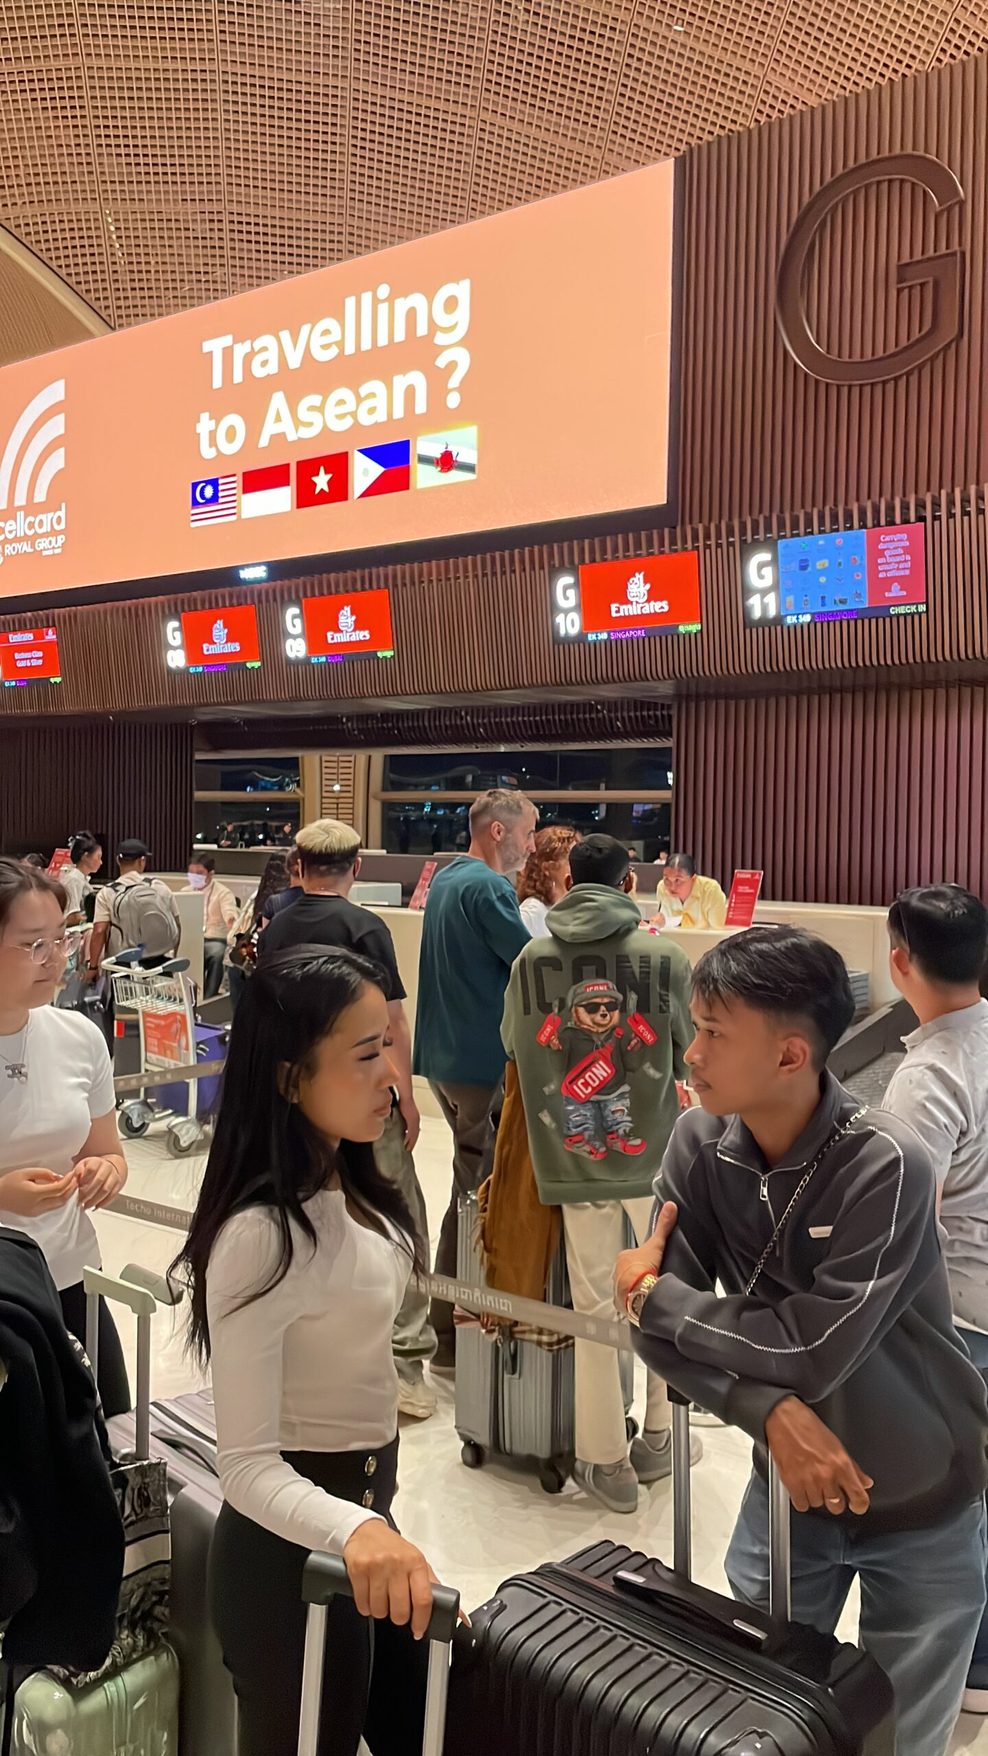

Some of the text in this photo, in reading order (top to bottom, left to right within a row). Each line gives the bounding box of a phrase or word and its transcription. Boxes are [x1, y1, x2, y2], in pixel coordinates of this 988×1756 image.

[775, 151, 966, 385] G
[202, 279, 471, 390] Travelling
[196, 346, 471, 460] to Asean ?
[5, 541, 34, 556] ROYAL
[35, 534, 66, 551] GROUP
[748, 552, 773, 588] G
[555, 576, 576, 608] G
[610, 600, 669, 618] Emirates
[747, 592, 777, 620] 11
[890, 604, 927, 615] CHECK IN
[285, 607, 302, 635] G
[555, 612, 580, 637] 10
[786, 616, 797, 624] EK
[166, 621, 181, 647] G
[326, 630, 370, 643] Emirates
[610, 629, 646, 640] SINGAPORE
[203, 642, 240, 655] Emirates
[285, 638, 306, 658] 09
[519, 954, 671, 1016] ICONI
[573, 1060, 612, 1099] ICONI
[126, 1200, 190, 1225] Techo Internat
